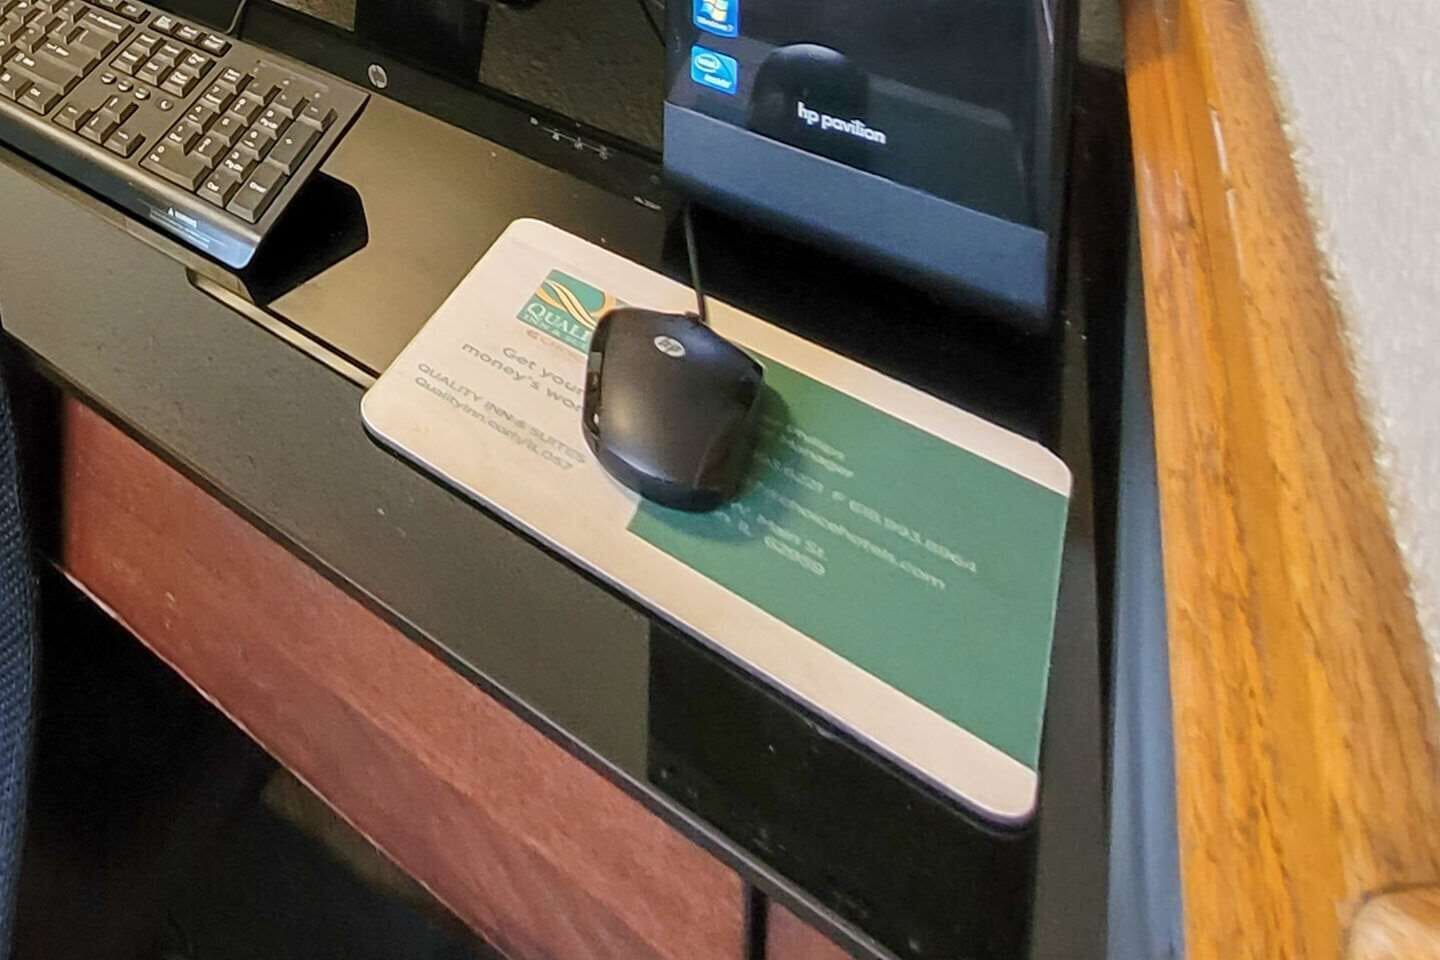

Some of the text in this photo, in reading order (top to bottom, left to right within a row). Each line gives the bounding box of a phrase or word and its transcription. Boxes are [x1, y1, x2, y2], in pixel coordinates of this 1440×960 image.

[797, 101, 887, 144] hp pavilion
[527, 303, 592, 341] QUALI
[656, 337, 684, 355] hp
[418, 363, 482, 401] QUALITY
[462, 343, 539, 390] money's
[546, 388, 582, 412] wor
[502, 347, 584, 394] Get your
